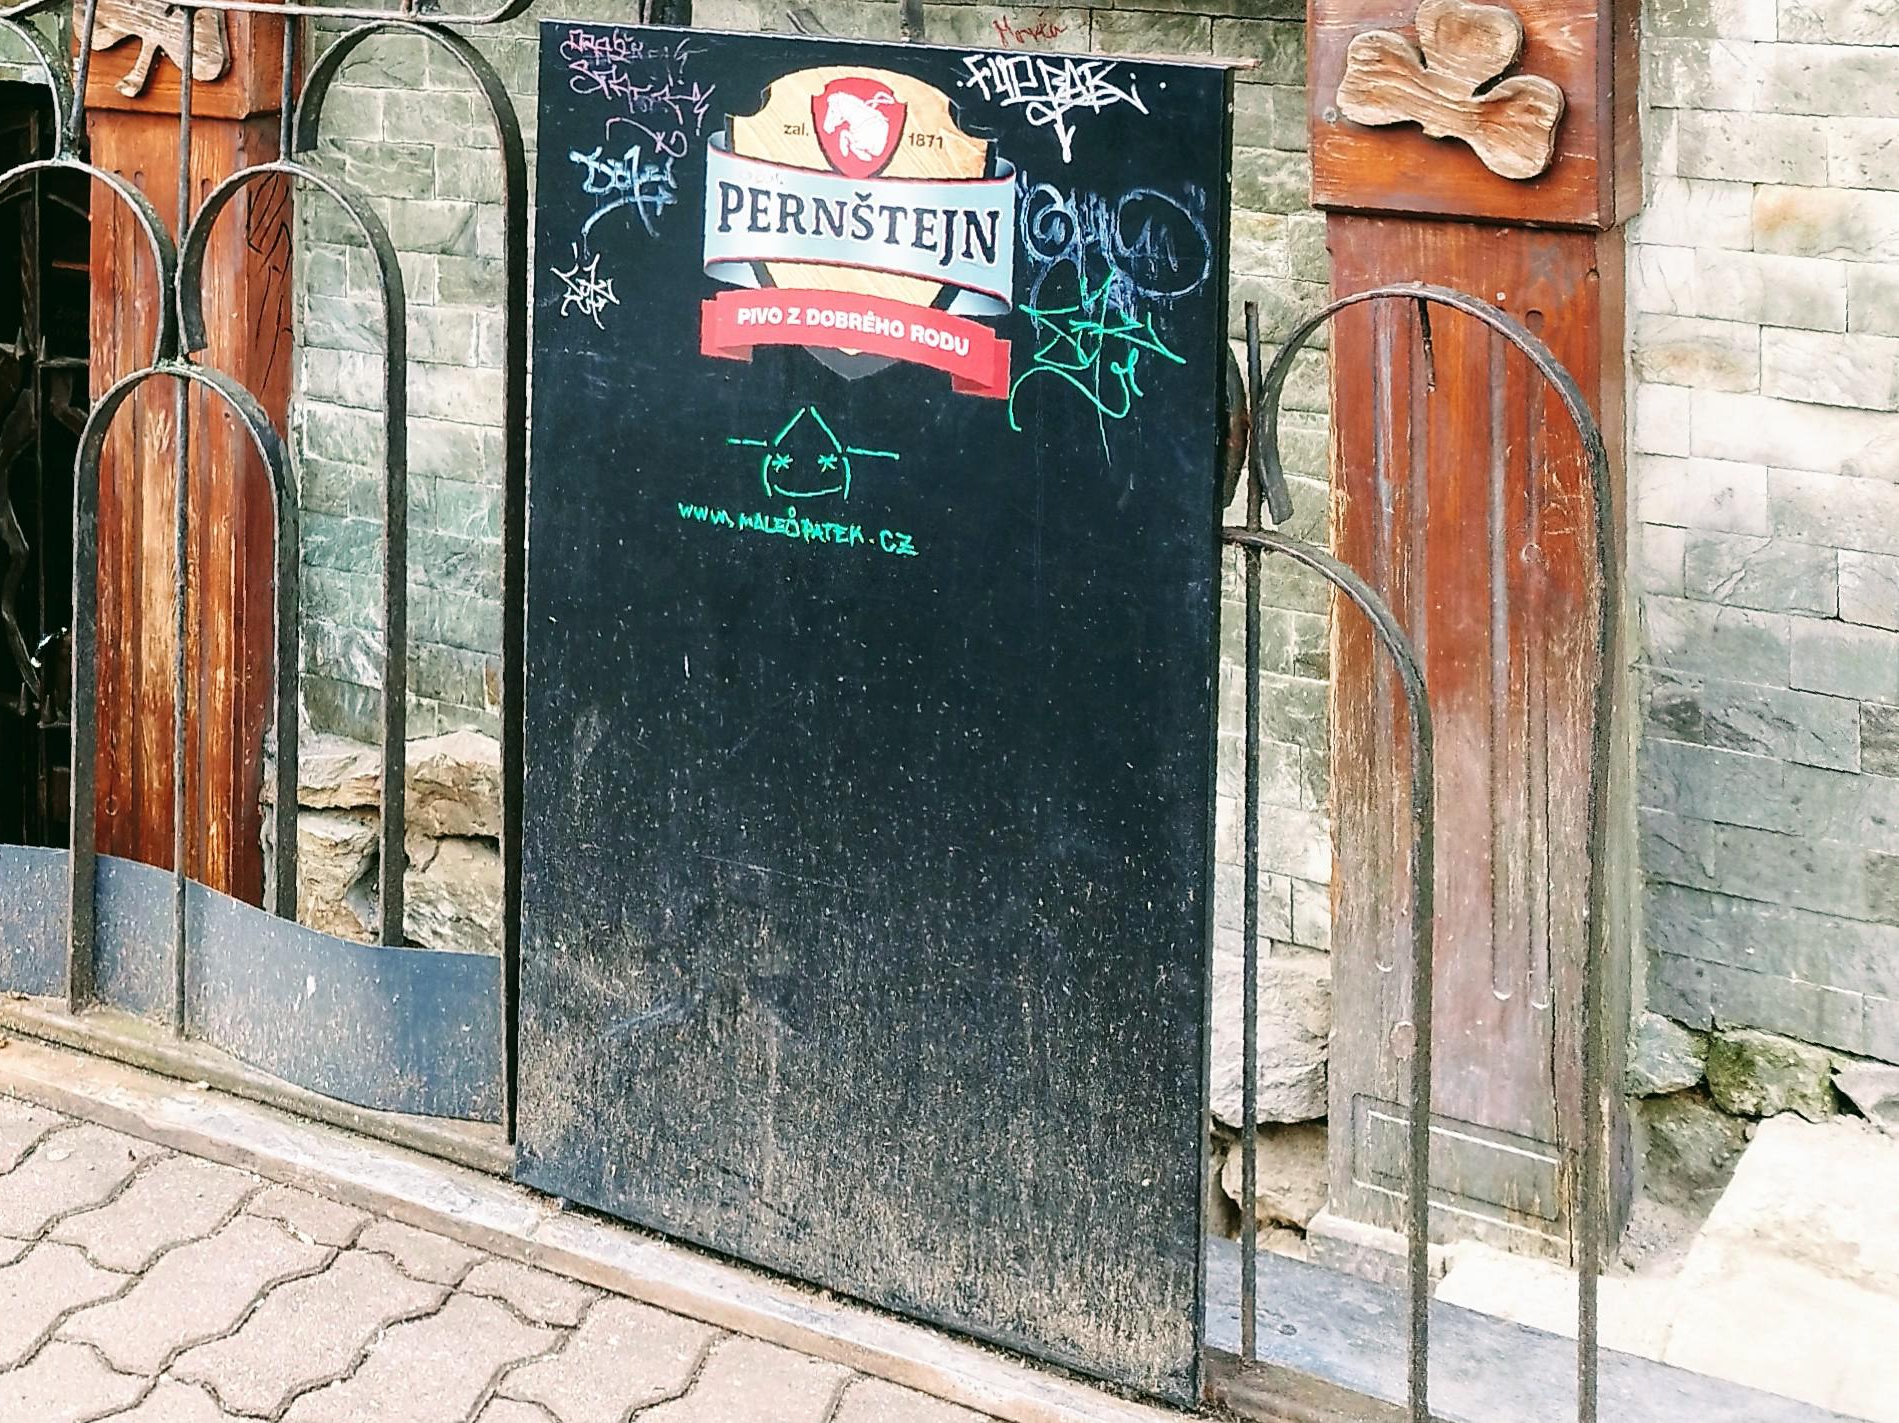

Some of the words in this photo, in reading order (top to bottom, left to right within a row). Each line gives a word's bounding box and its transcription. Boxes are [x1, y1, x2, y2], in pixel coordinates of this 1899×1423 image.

[783, 123, 810, 137] zal.
[907, 132, 944, 150] 1871
[716, 181, 1000, 267] PERNŠTEJN
[736, 307, 783, 326] PIVO
[786, 307, 802, 325] Z
[806, 308, 905, 339] DOBRÉHO
[910, 324, 970, 357] RODU
